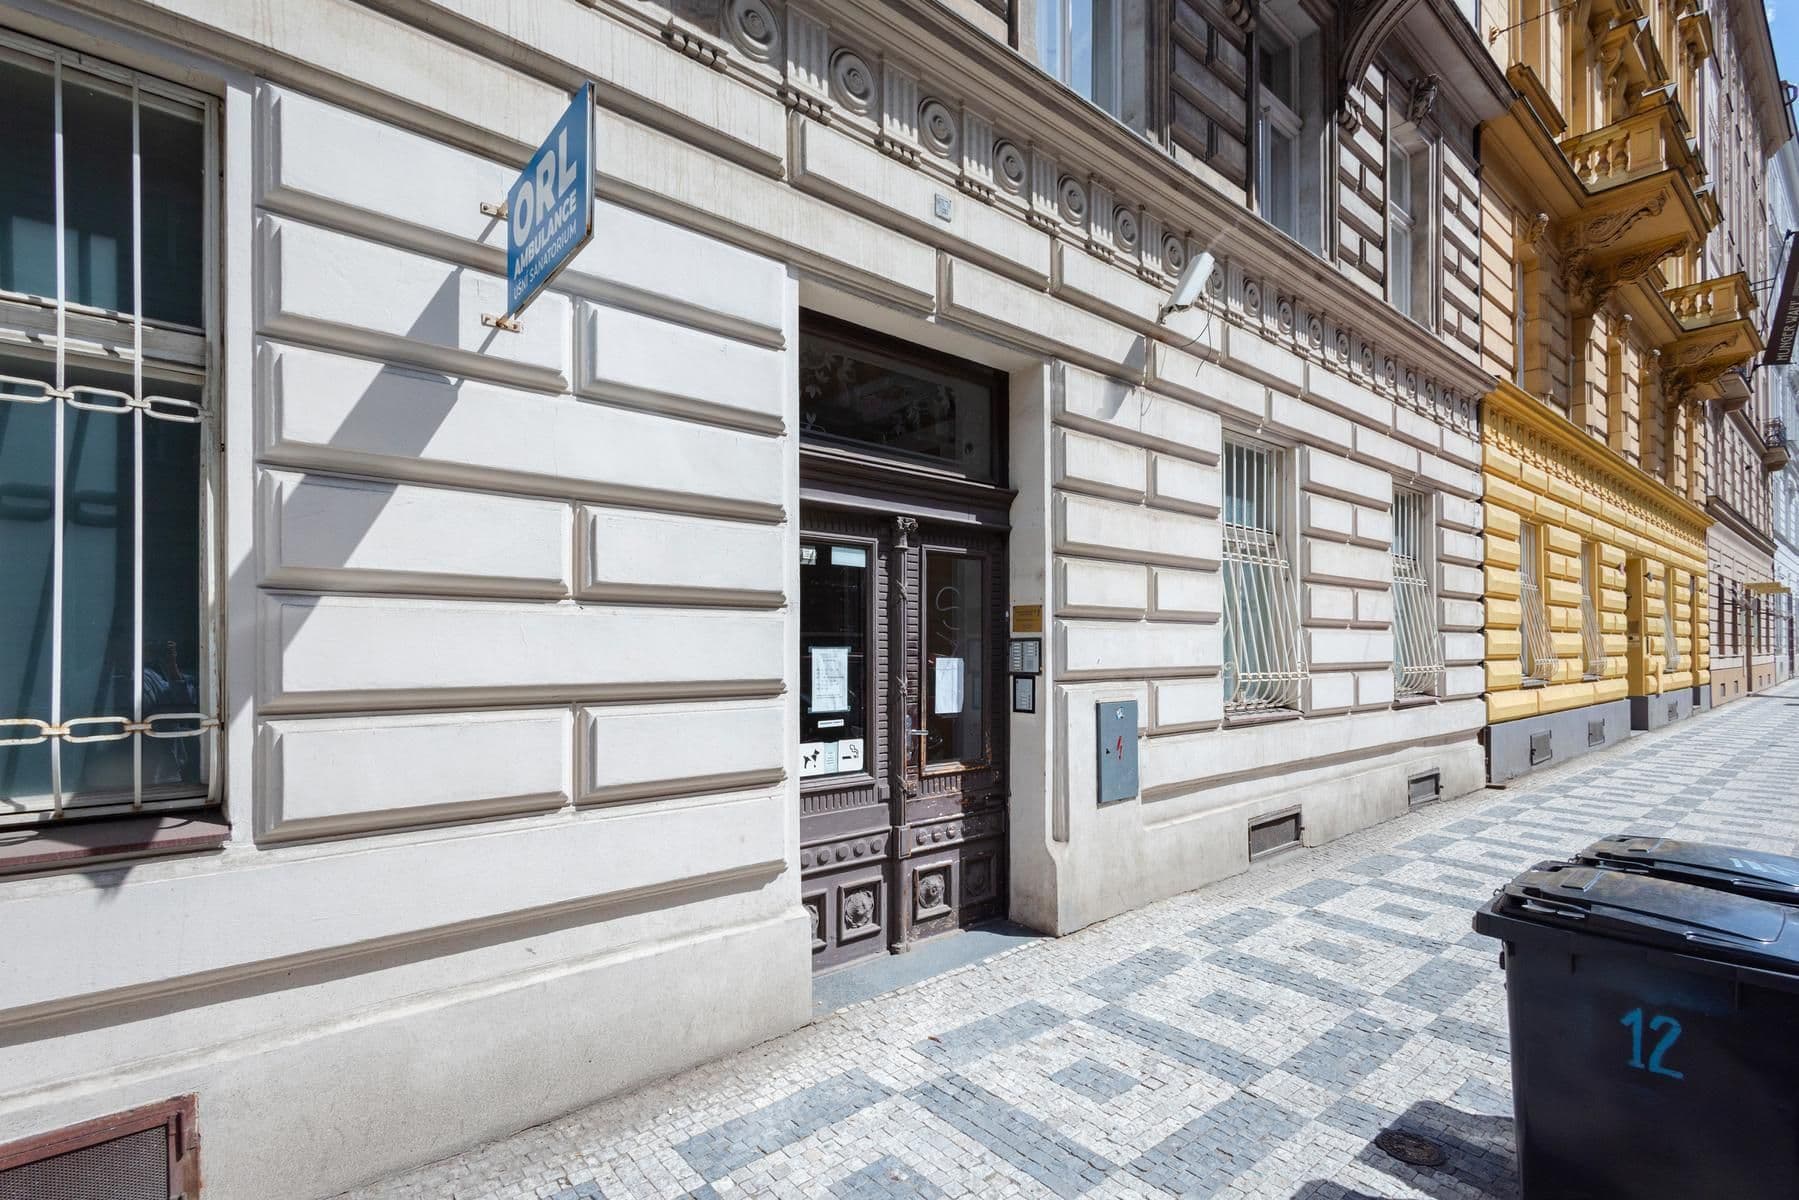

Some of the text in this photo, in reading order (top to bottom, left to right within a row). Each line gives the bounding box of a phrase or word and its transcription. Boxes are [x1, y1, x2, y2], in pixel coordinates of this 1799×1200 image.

[513, 126, 577, 247] ORL
[514, 189, 577, 280] AMBULANCE
[514, 220, 577, 299] UŠNÍ SANATORIUM
[1620, 1007, 1685, 1080] 12
